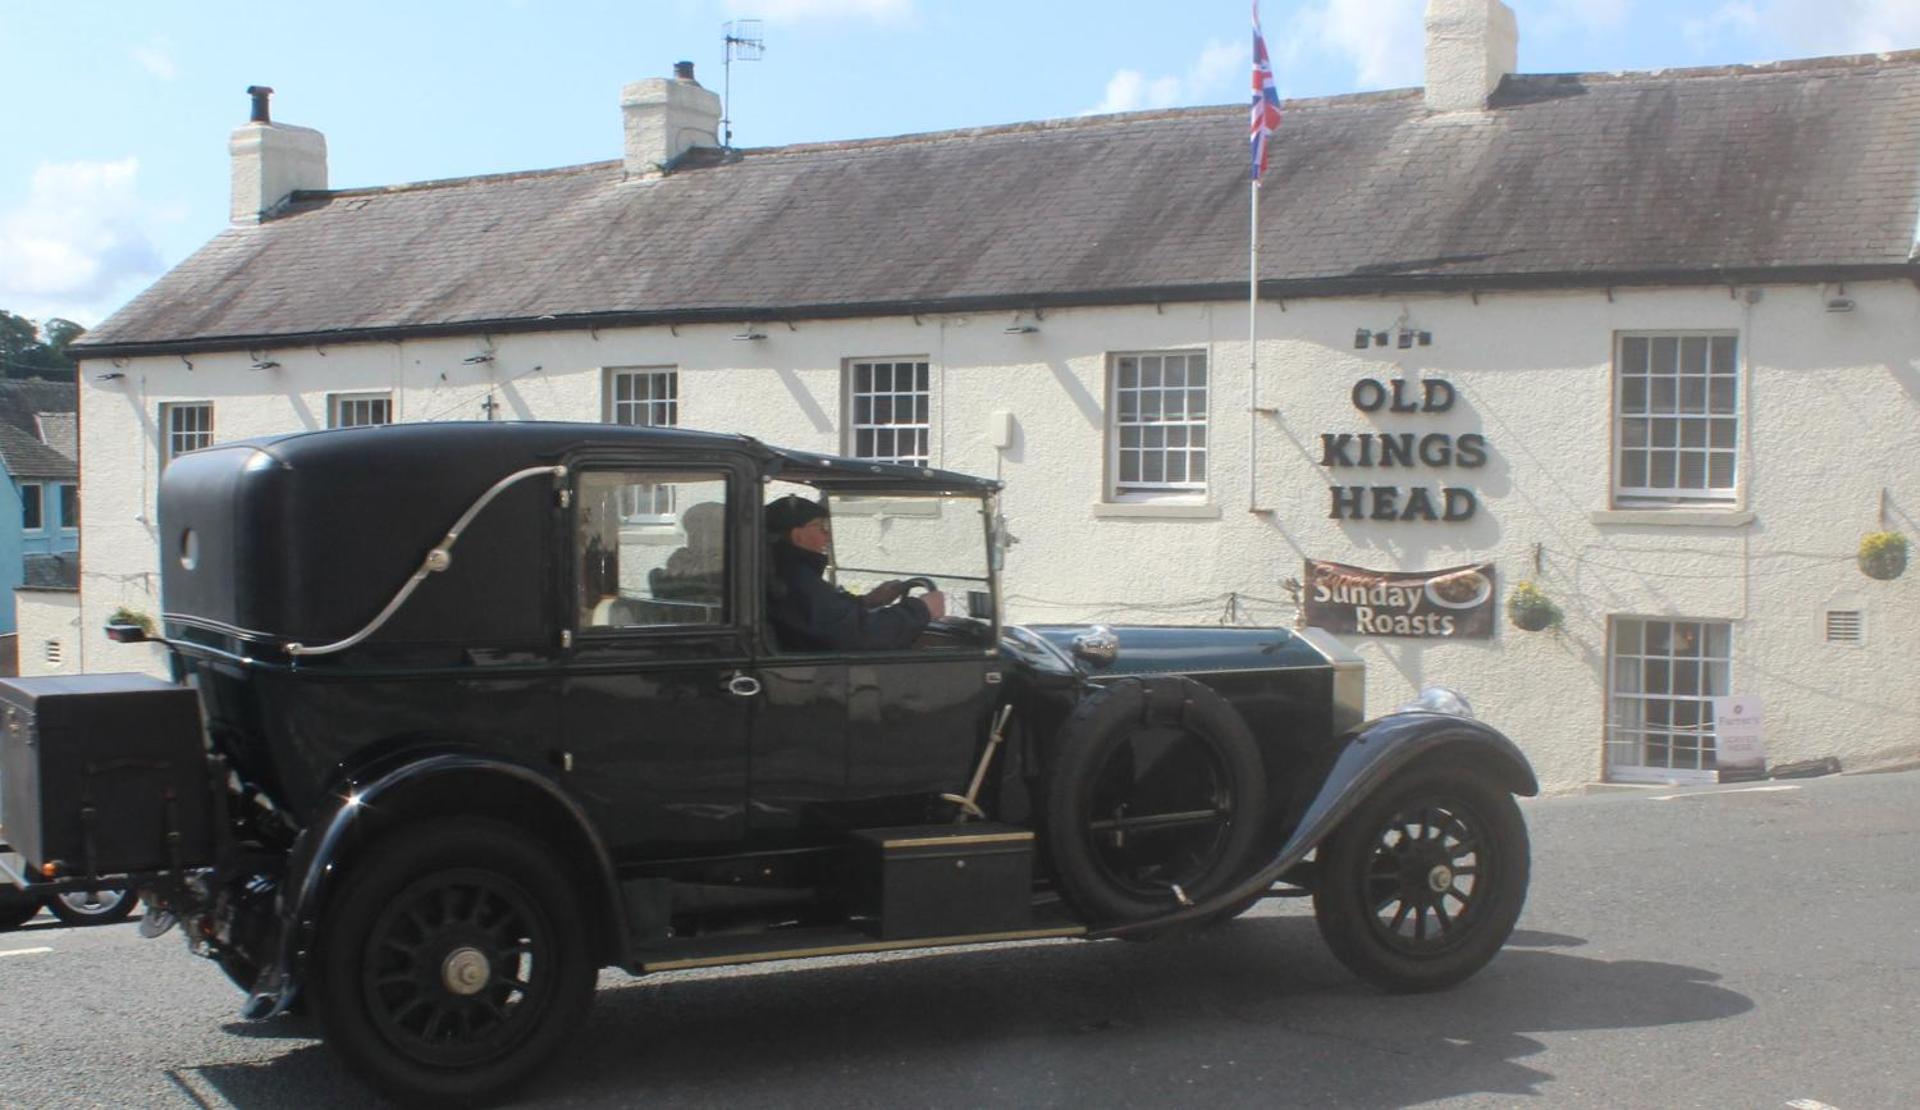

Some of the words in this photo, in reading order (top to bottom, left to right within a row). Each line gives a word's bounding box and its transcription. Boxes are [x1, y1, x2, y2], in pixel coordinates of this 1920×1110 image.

[1352, 378, 1456, 413] OLD
[1320, 433, 1487, 468] KINGS
[1329, 486, 1476, 521] HEAD
[1314, 577, 1423, 614] Sunday
[1356, 606, 1455, 636] Roasts
